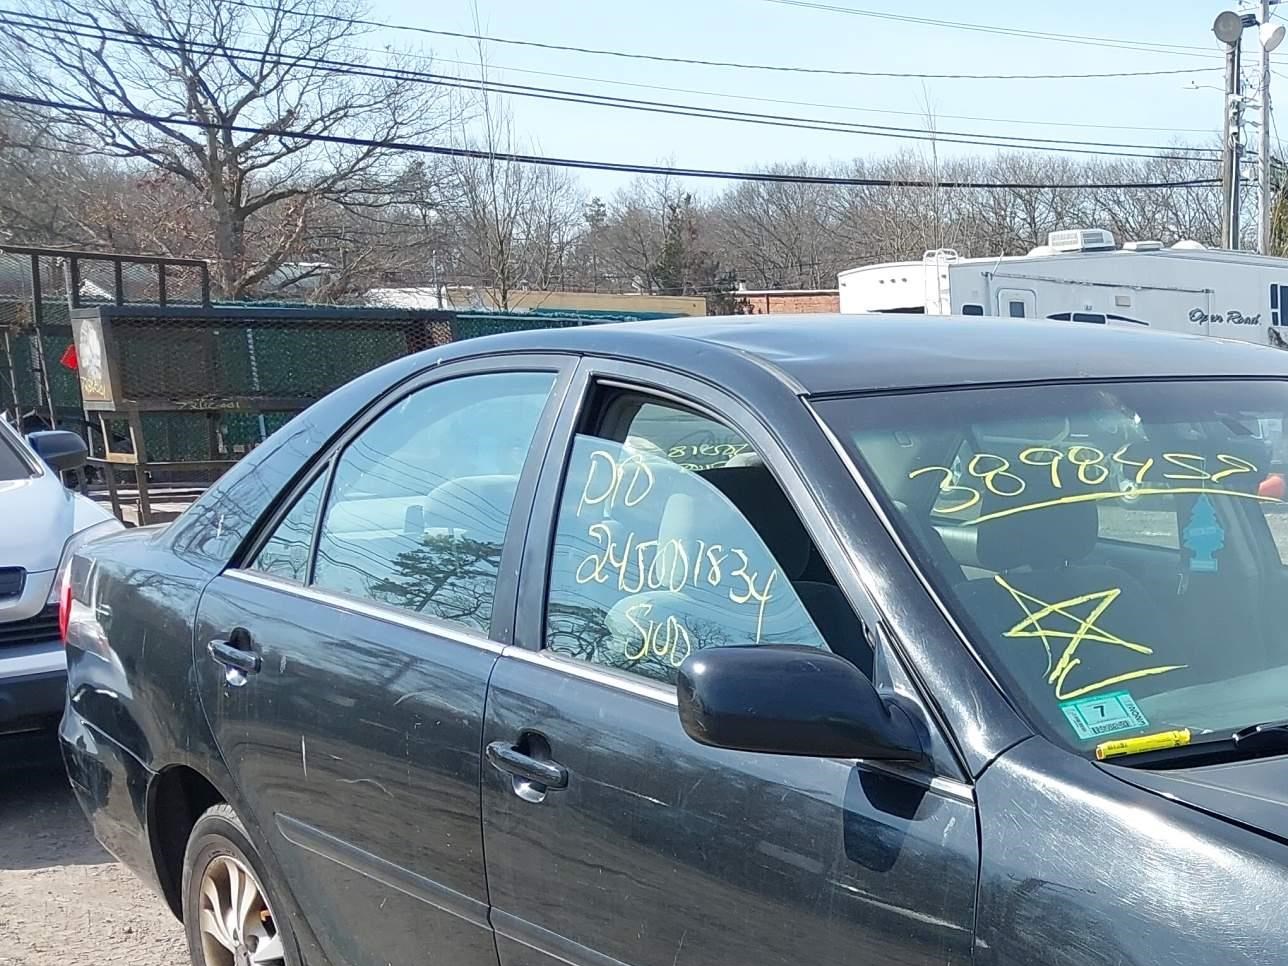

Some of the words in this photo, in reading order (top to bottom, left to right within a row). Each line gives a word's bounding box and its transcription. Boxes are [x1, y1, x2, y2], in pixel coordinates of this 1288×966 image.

[1188, 308, 1224, 326] Open
[1226, 310, 1261, 326] Road
[1093, 705, 1106, 717] 7
